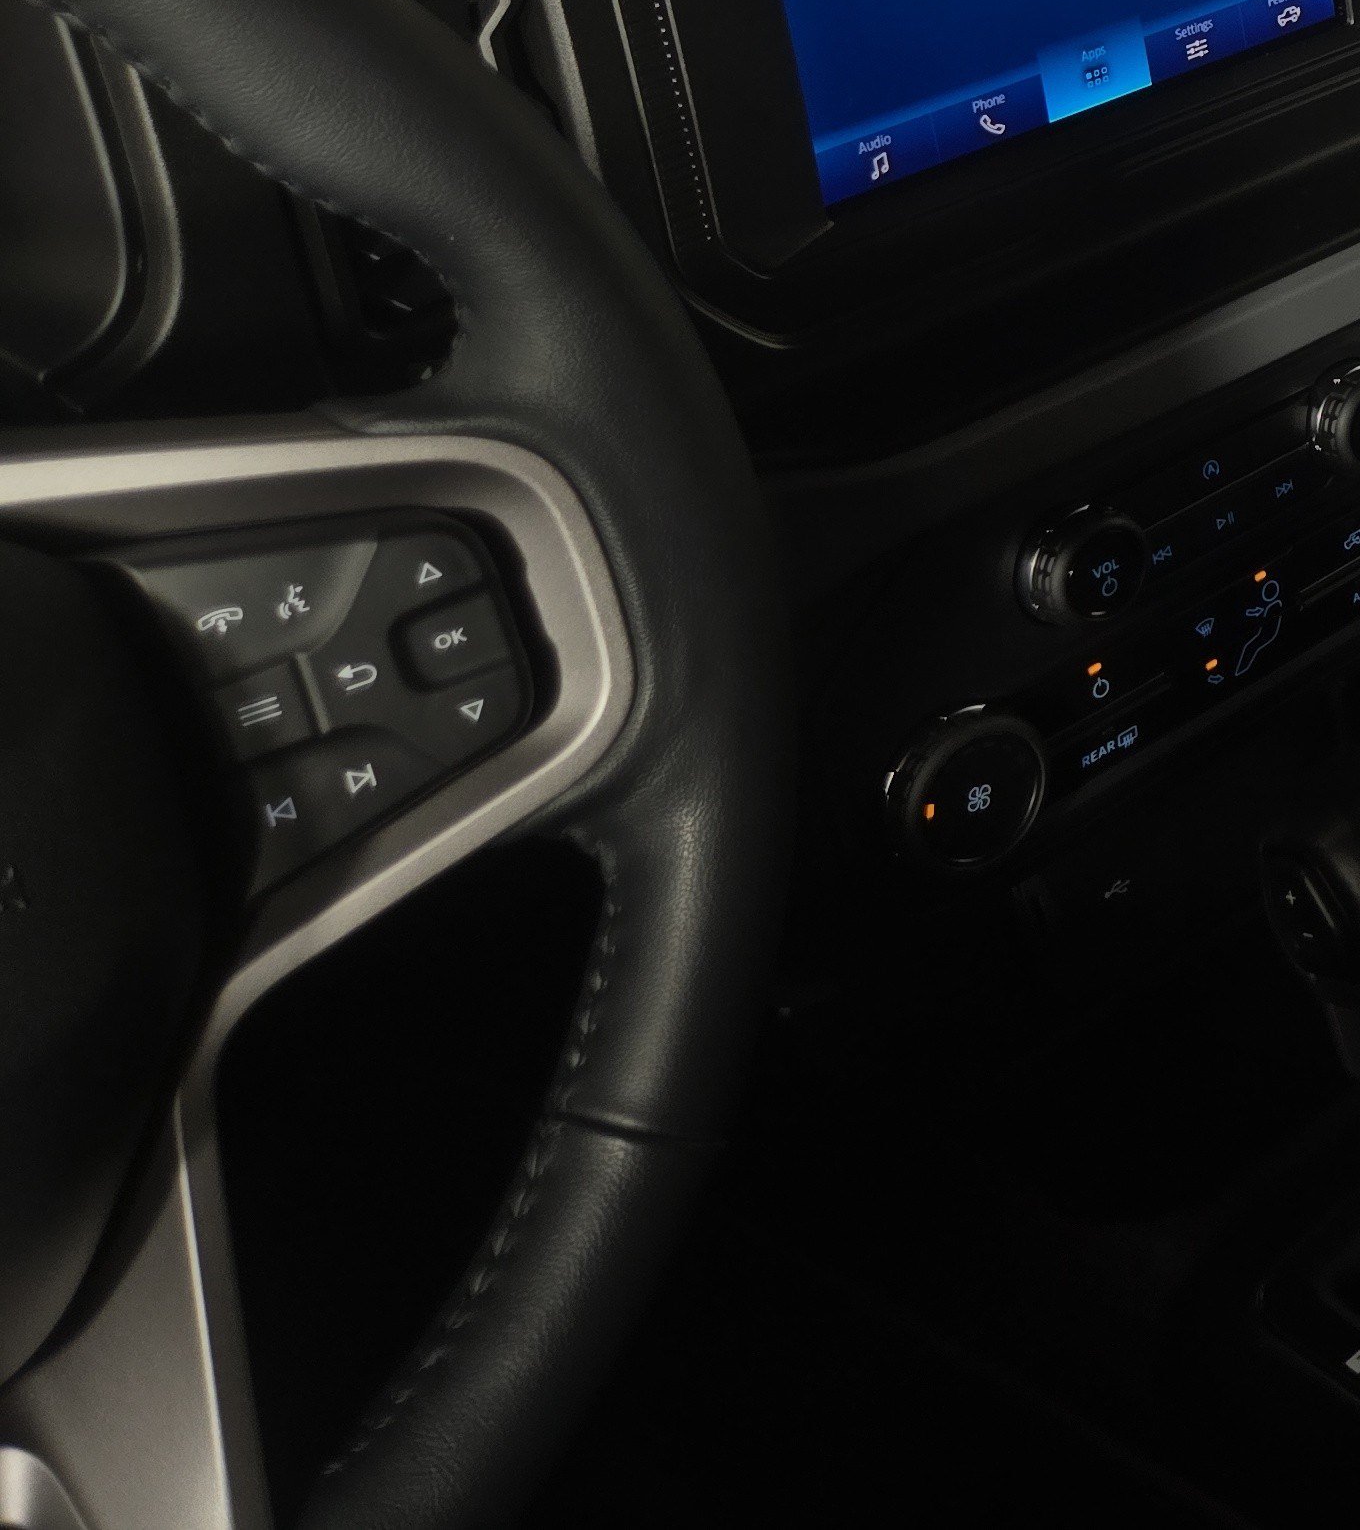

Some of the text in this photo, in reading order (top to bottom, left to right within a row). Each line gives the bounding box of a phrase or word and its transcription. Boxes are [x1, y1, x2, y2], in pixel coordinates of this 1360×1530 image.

[1174, 16, 1214, 42] Settings
[1080, 43, 1107, 63] Apps
[971, 91, 1007, 114] Phone
[858, 132, 892, 156] Audio
[1091, 558, 1121, 580] VOL
[433, 626, 468, 650] OK
[1080, 739, 1117, 769] REAR
